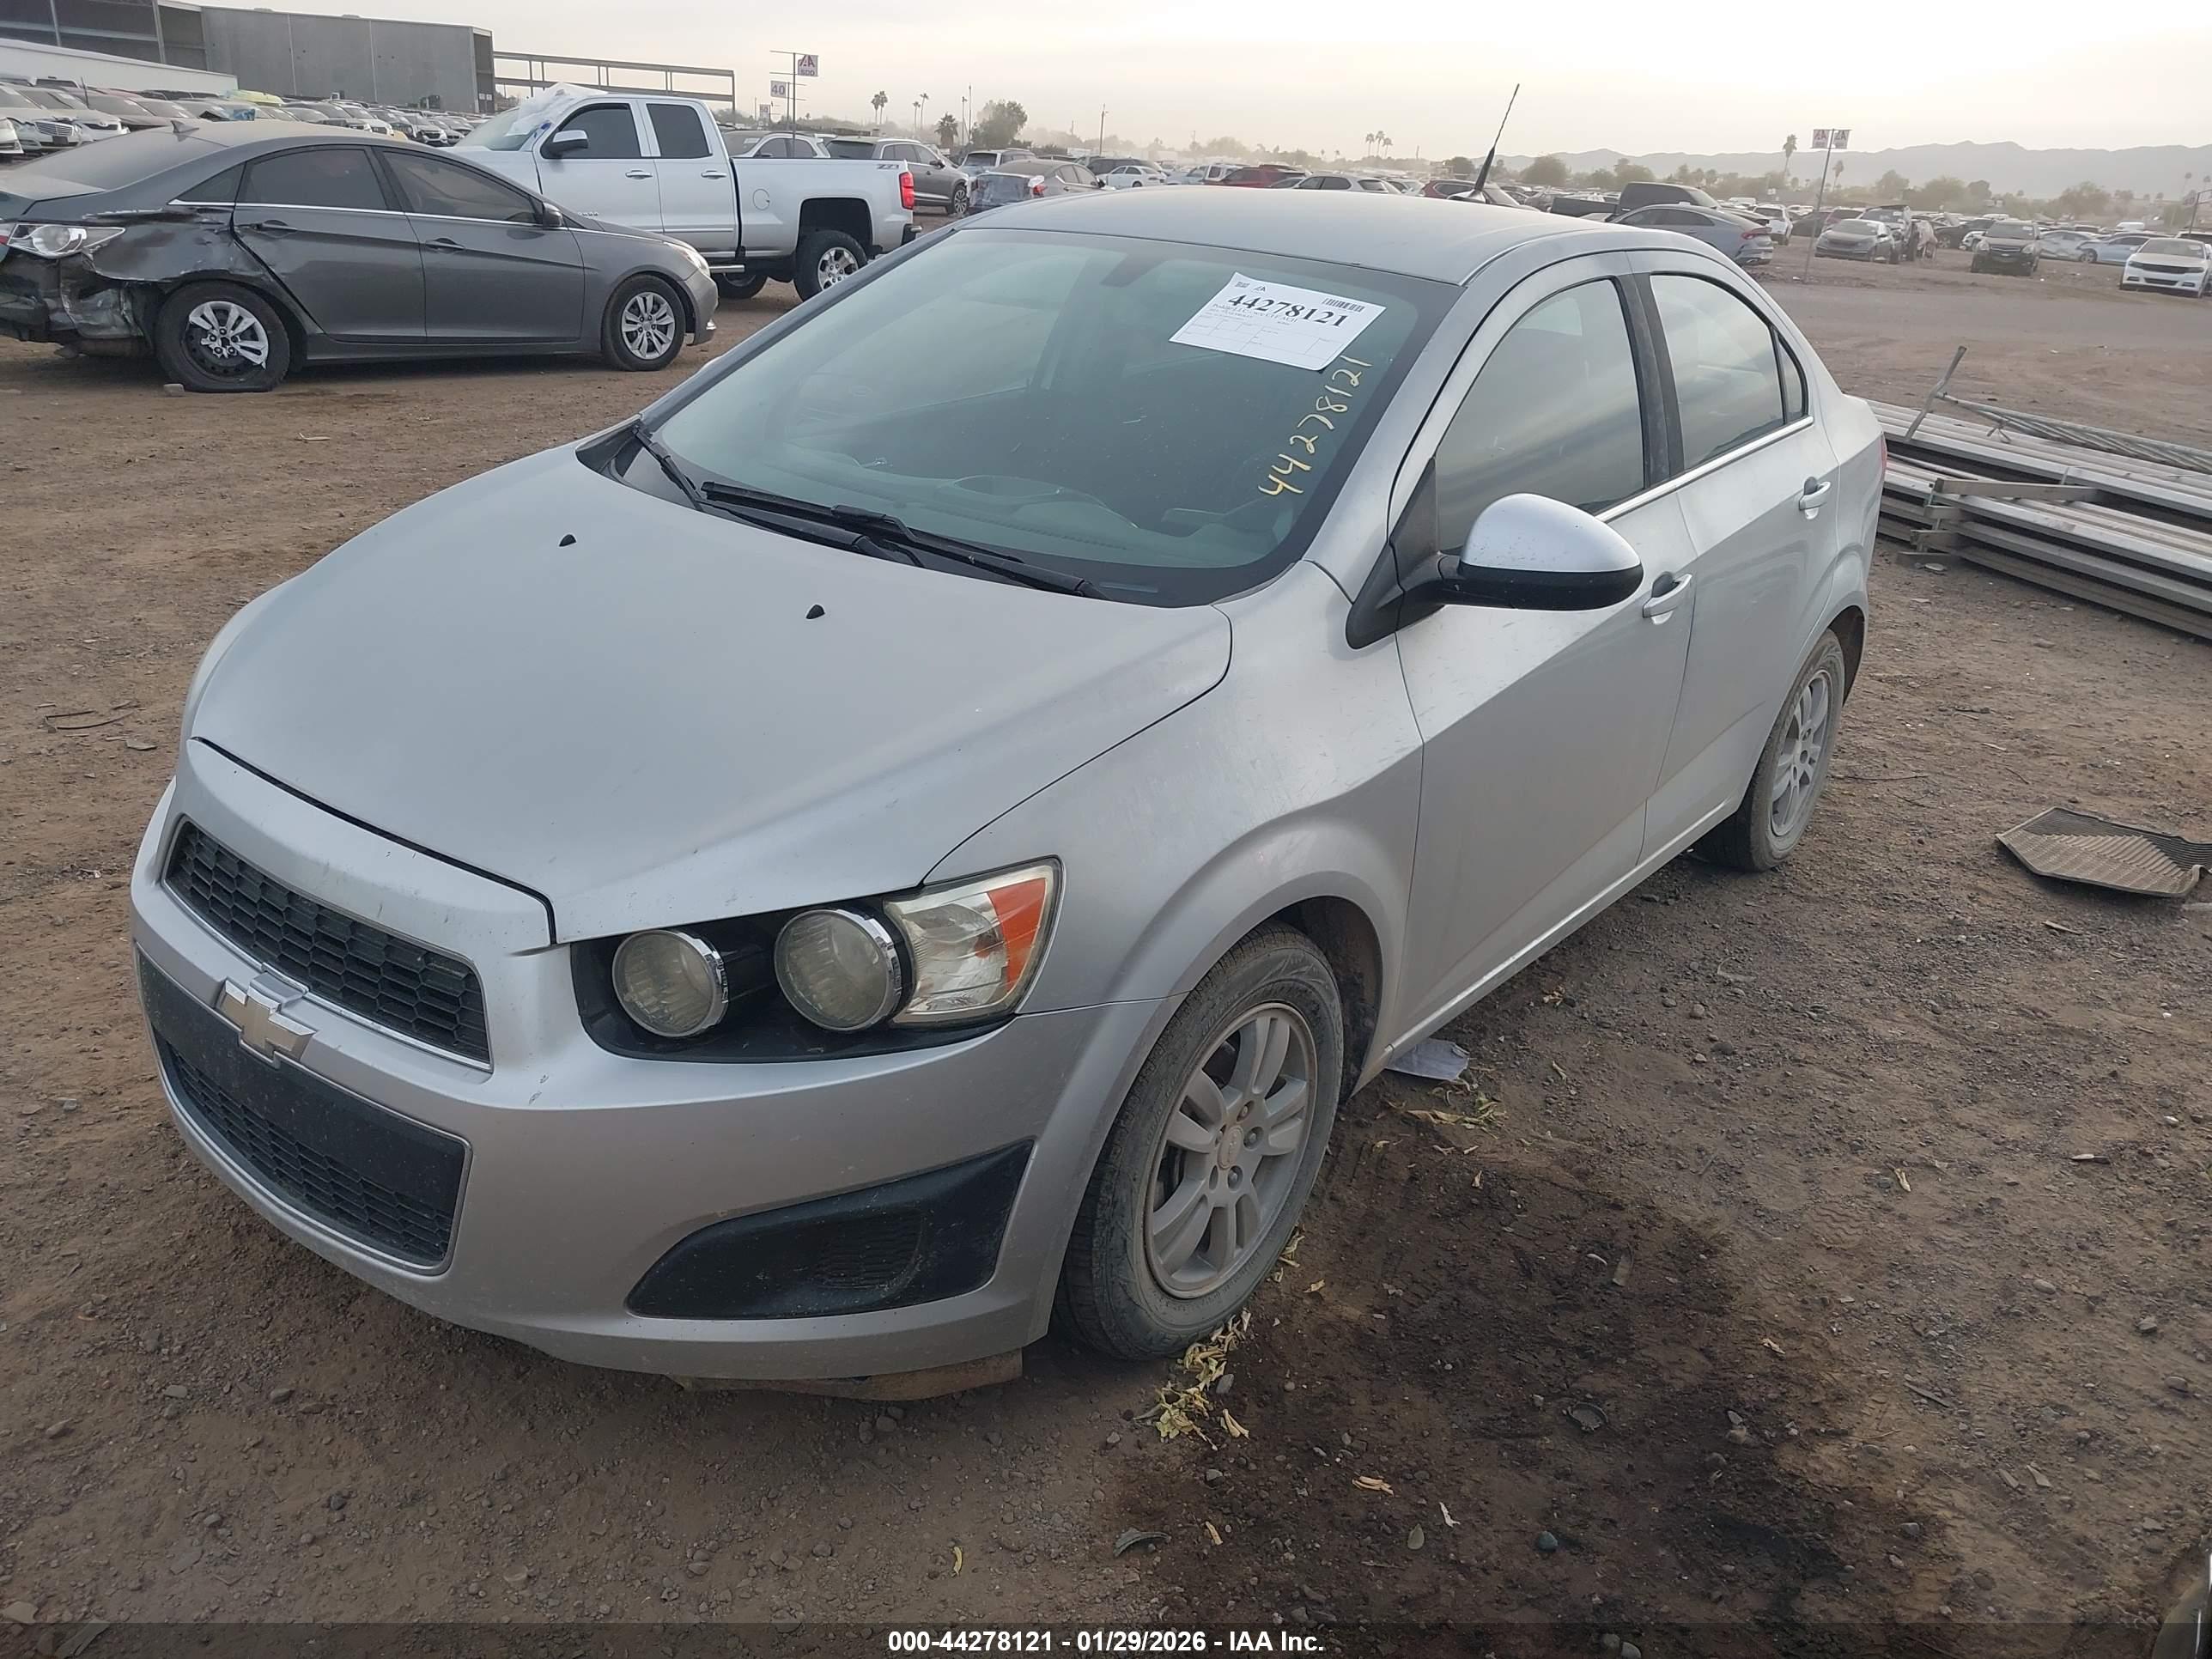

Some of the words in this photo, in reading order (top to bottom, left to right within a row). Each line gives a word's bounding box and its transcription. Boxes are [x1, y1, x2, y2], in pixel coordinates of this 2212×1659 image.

[771, 85, 785, 95] 40
[1228, 294, 1348, 327] 44278121
[1258, 355, 1372, 495] 44278121
